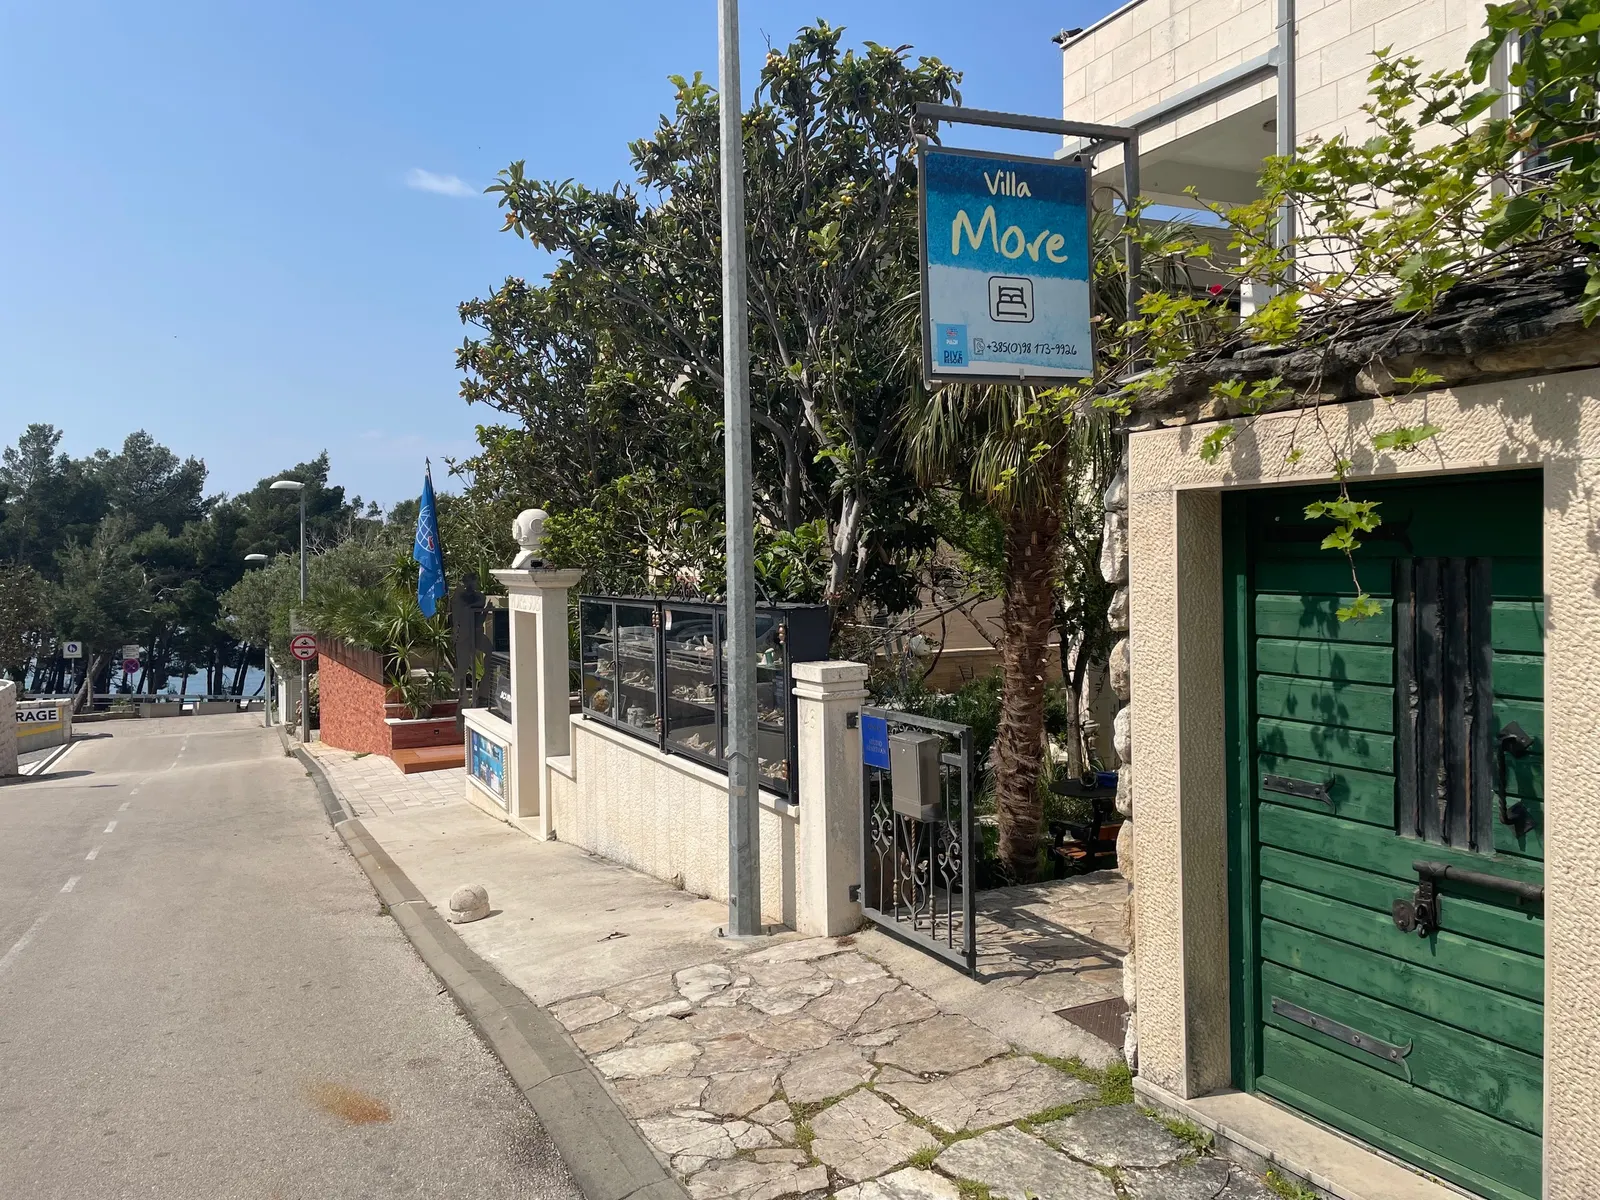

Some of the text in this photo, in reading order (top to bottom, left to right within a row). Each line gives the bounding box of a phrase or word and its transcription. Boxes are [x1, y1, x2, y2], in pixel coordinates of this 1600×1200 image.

[983, 168, 1032, 198] Villa
[951, 204, 1069, 264] More
[943, 350, 963, 360] DIVE
[986, 341, 1032, 354] +385(0)98
